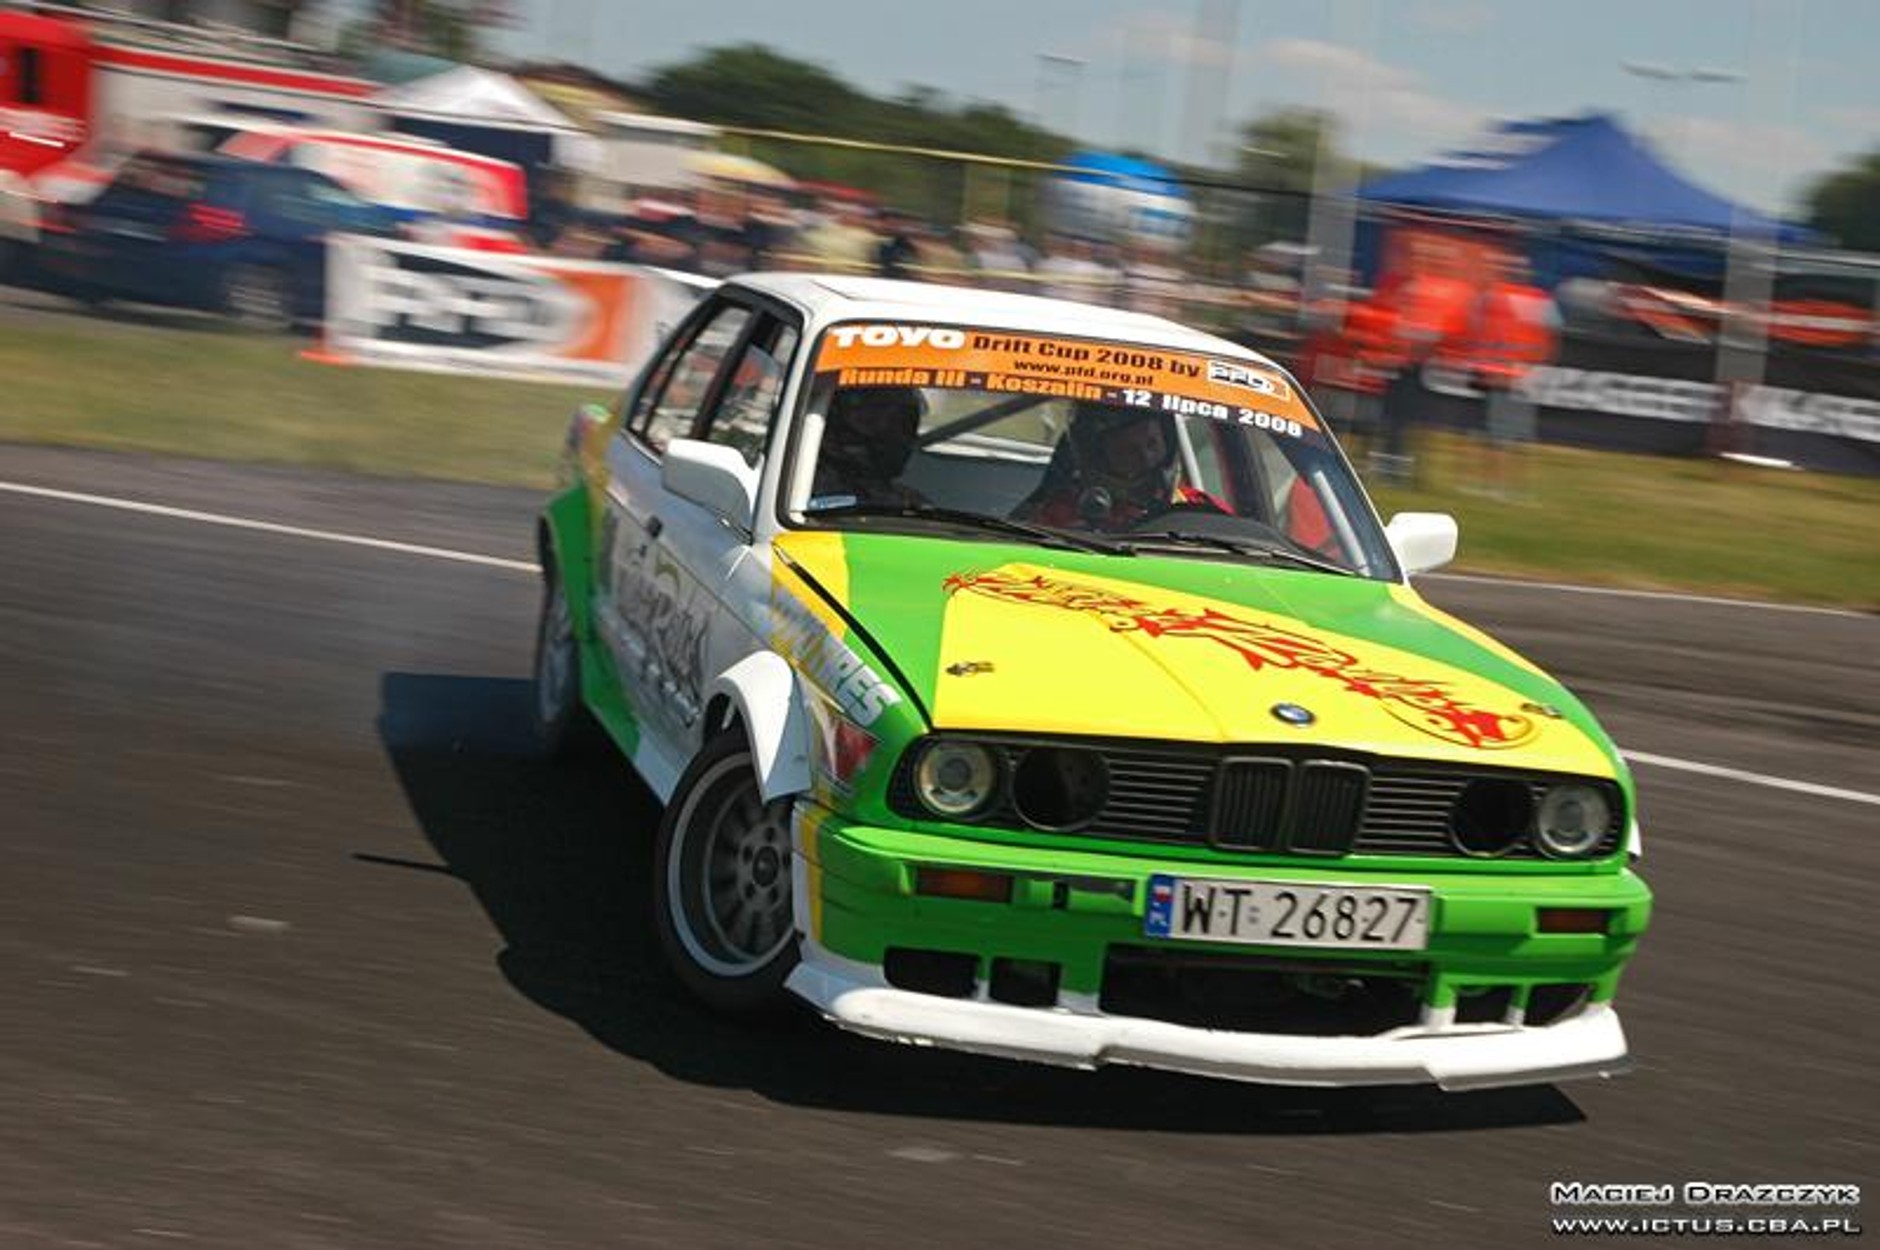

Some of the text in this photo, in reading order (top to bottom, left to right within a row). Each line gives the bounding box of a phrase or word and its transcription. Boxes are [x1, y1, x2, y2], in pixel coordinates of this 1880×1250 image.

[830, 325, 966, 349] TOYO
[973, 336, 1031, 353] Drift
[1038, 341, 1089, 362] Cup
[1096, 348, 1163, 371] 2008
[1169, 359, 1201, 378] by
[839, 367, 931, 387] Runda
[935, 369, 966, 387] III
[986, 373, 1102, 400] Koszalin
[1122, 389, 1152, 407] 12
[1161, 394, 1229, 420] lipca
[1238, 408, 1303, 438] 2008
[1270, 891, 1419, 944] 26827
